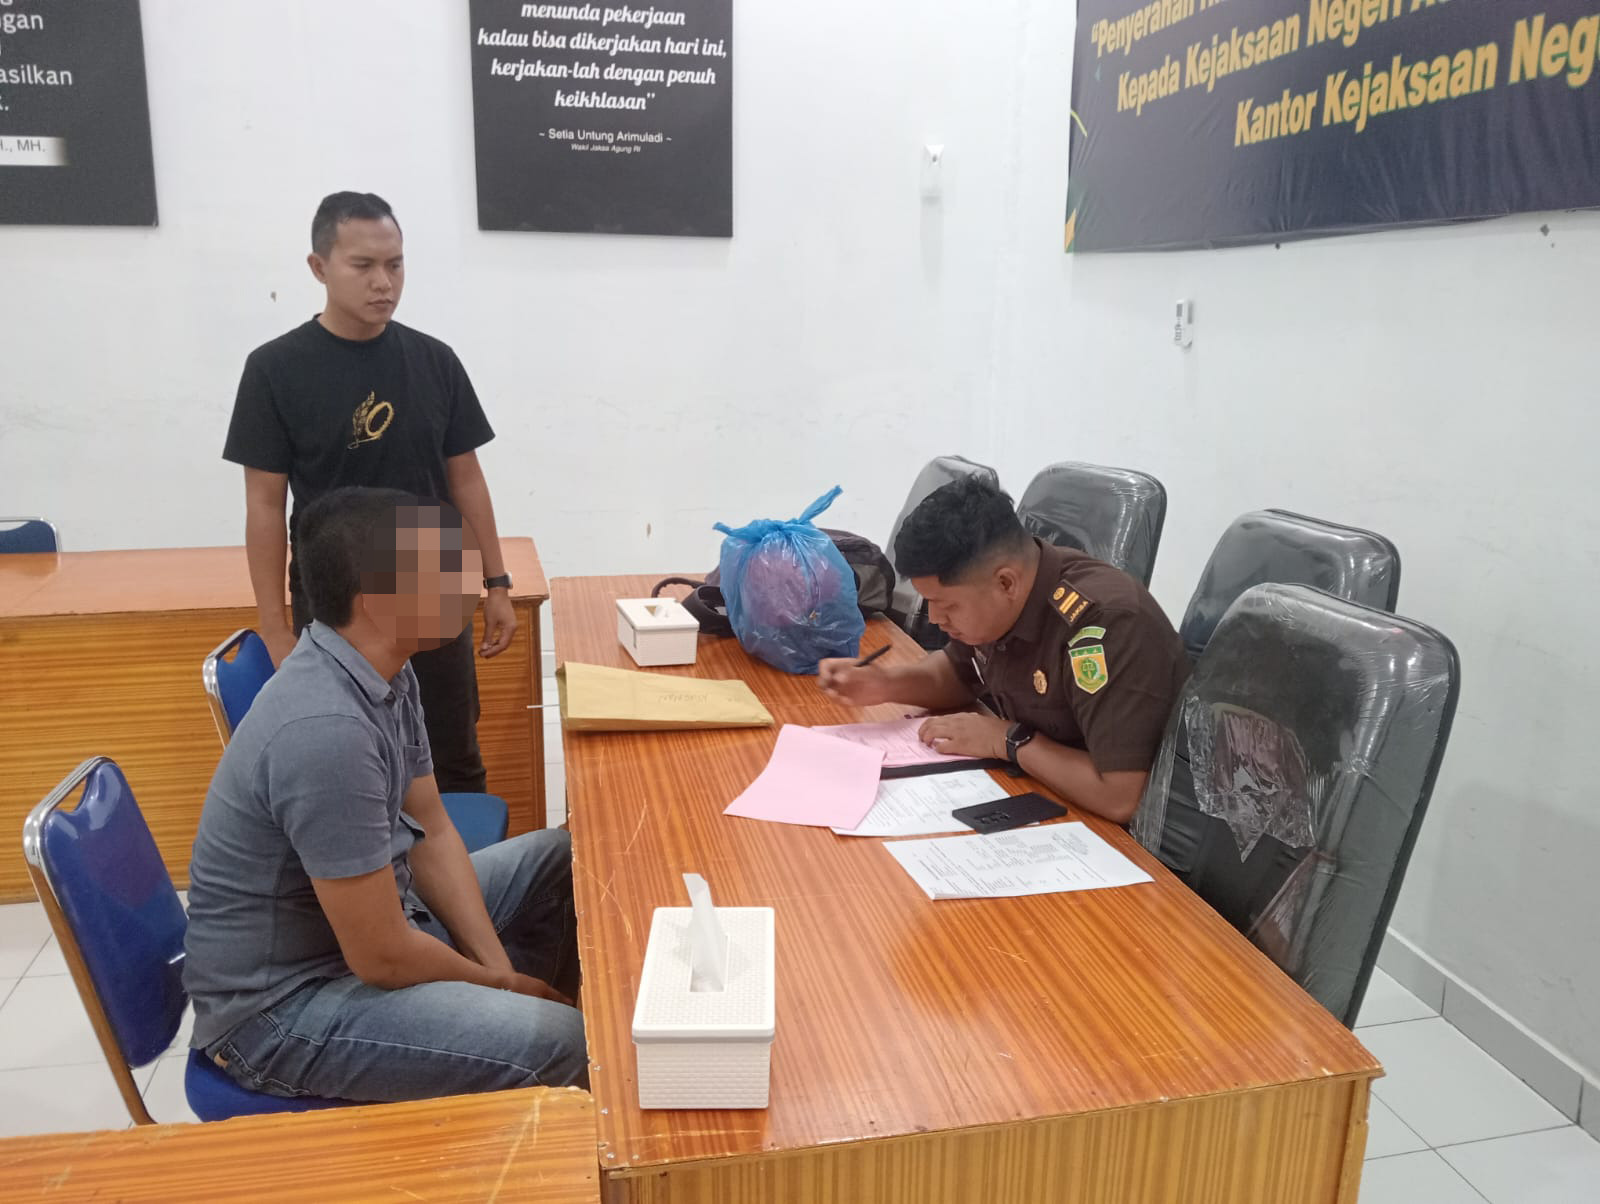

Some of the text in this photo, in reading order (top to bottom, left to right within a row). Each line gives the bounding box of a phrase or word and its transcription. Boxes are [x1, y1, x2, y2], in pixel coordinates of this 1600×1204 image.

[0, 13, 43, 34] gan
[521, 3, 686, 29] menunda pekerjaan
[477, 28, 727, 58] kalau bisa dikerjakan hari ini,
[491, 58, 716, 87] kerjakan-lah dengan penuh
[1117, 53, 1181, 117] Kepada
[1184, 13, 1300, 93] Kejaksaan
[1235, 12, 1600, 148] Kantor Kejaksaan Neg
[548, 128, 575, 140] Setia
[577, 129, 615, 143] Untung
[616, 131, 664, 143] Arimuladi
